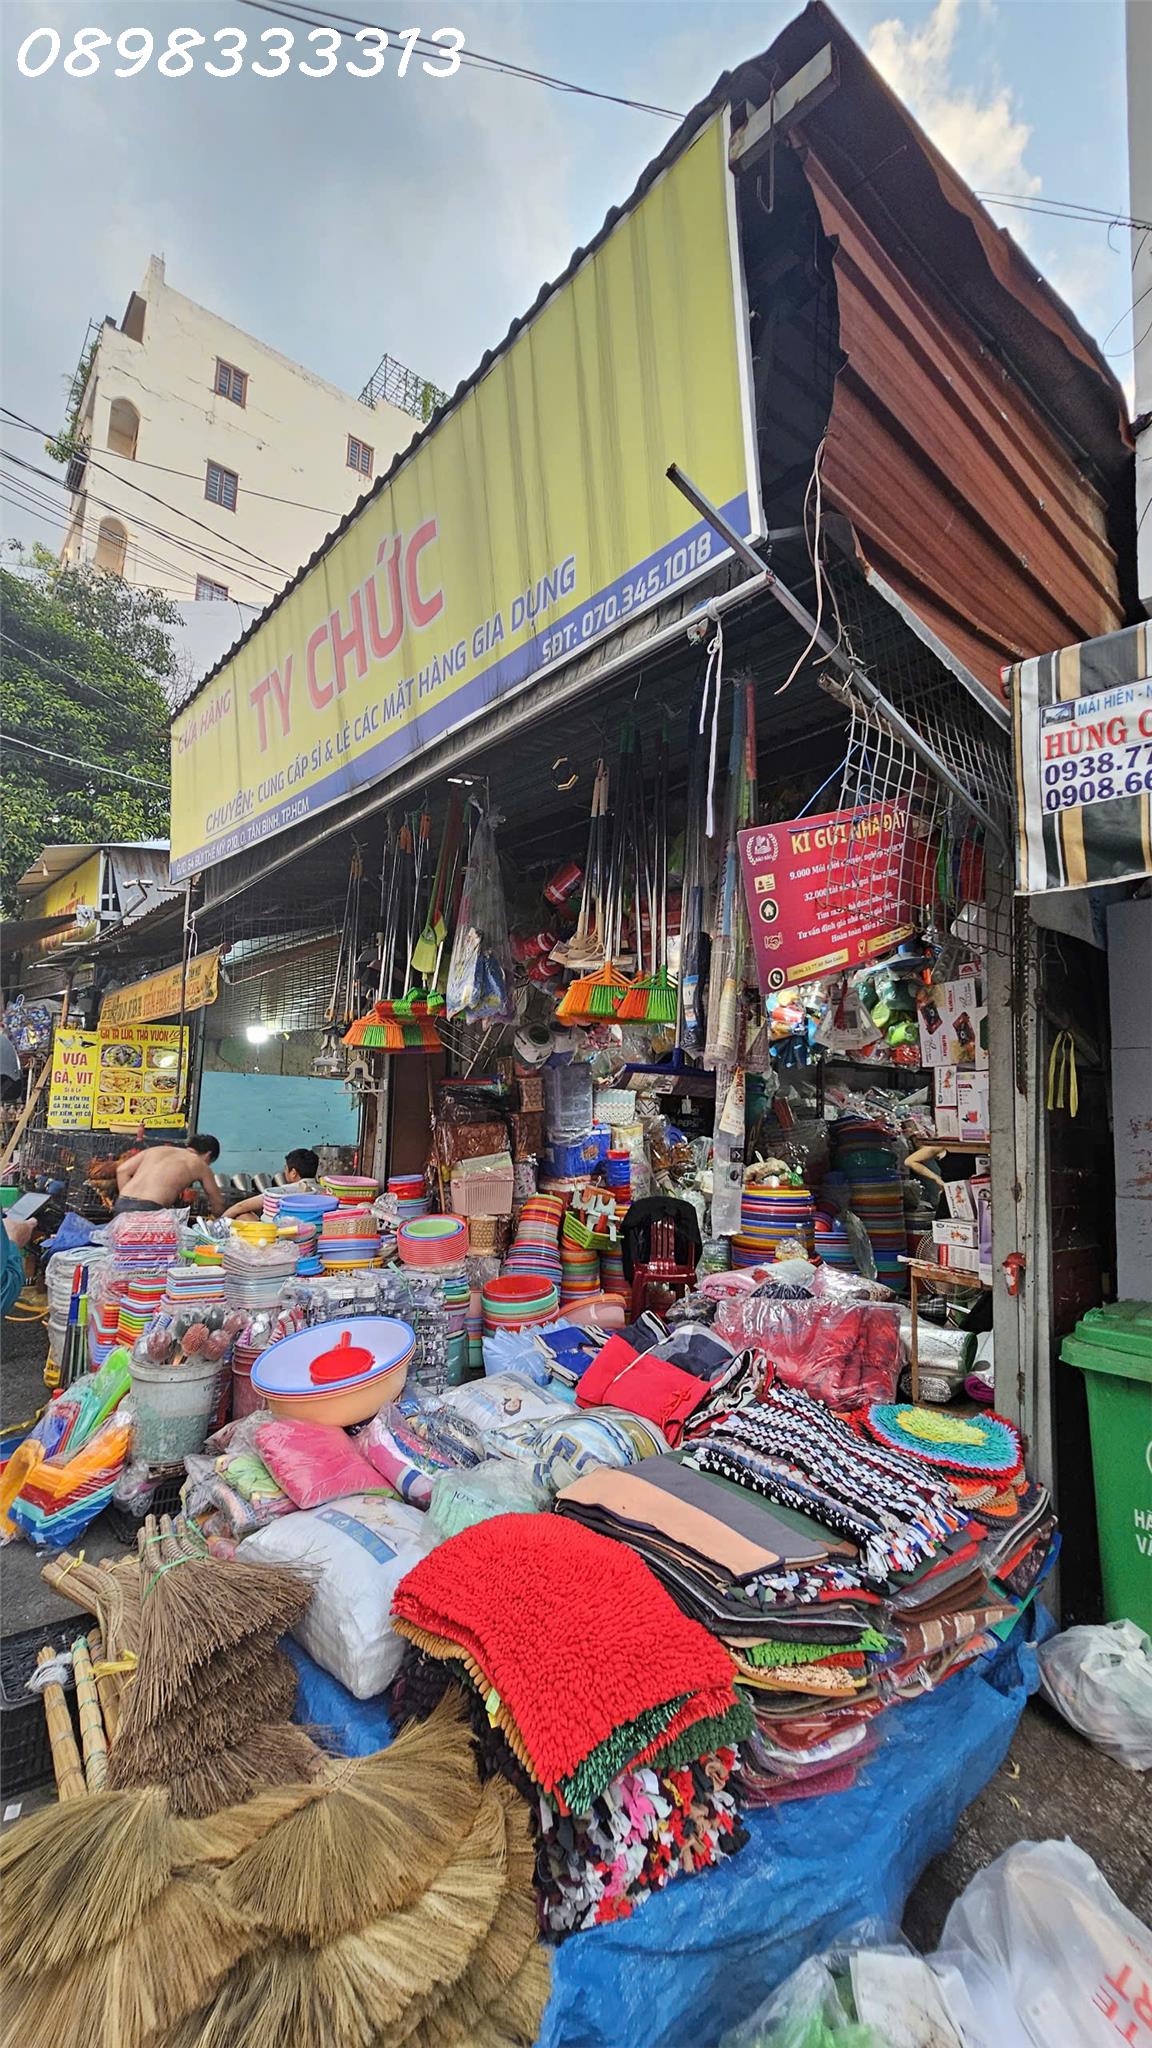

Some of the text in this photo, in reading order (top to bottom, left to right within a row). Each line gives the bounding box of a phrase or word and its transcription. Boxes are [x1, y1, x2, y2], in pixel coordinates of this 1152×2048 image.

[542, 530, 712, 664] SĐT: 070.345.1018
[250, 519, 443, 752] TY CHỨC
[200, 688, 232, 737] HÀNG
[205, 555, 575, 833] CHUYÊN: CUNG CẤP SỈ & LẺ CÁC MẶT HÀNG GIA DỤNG
[1077, 697, 1100, 717] MÁI
[1044, 716, 1128, 761] HÙNG
[247, 823, 261, 840] TÂN
[63, 1052, 88, 1069] VỰA
[77, 1071, 93, 1087] VỊT
